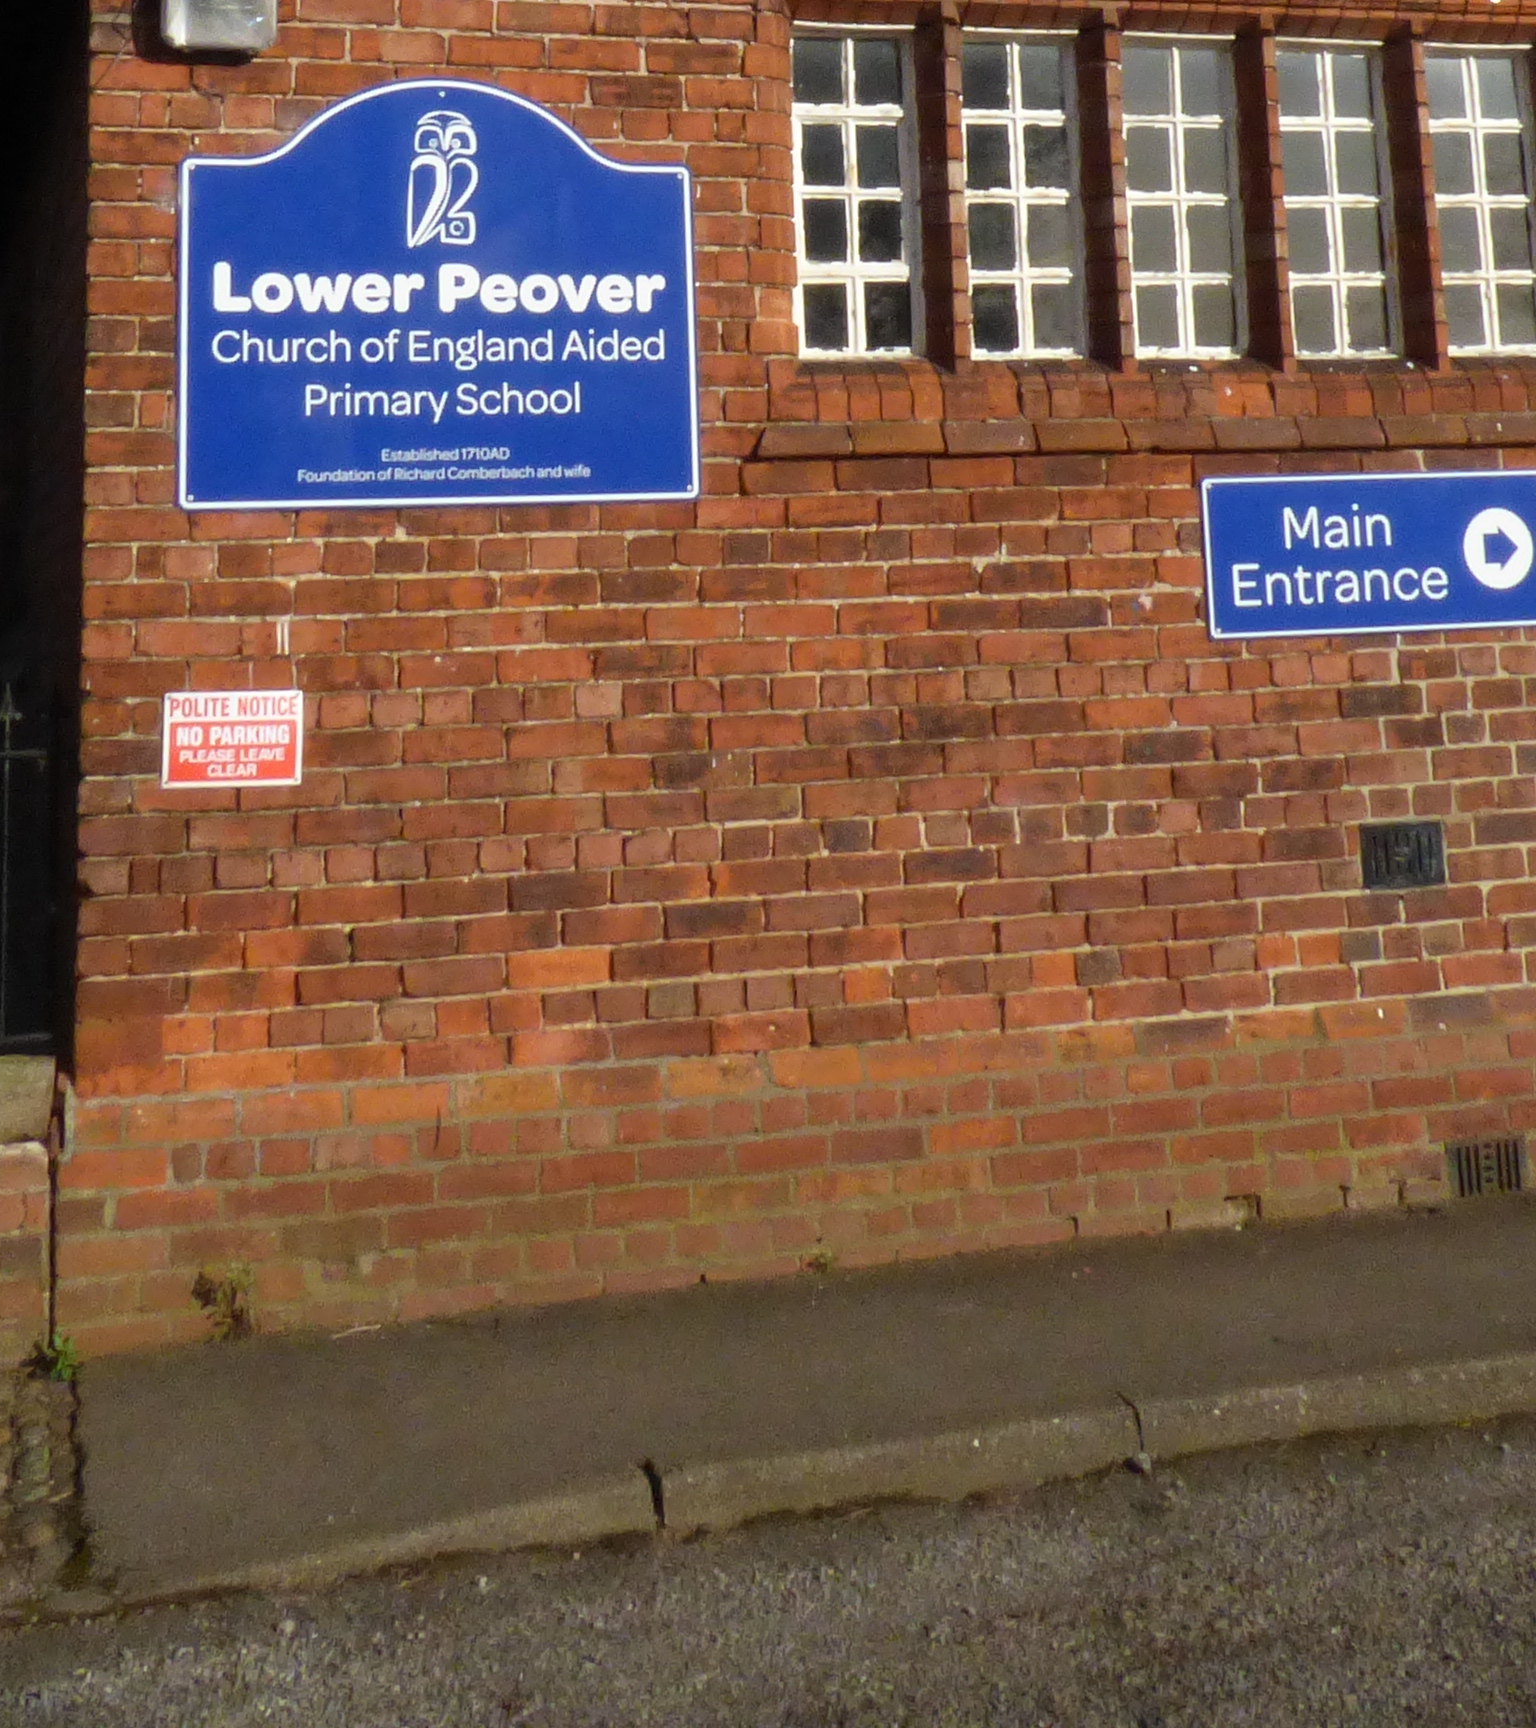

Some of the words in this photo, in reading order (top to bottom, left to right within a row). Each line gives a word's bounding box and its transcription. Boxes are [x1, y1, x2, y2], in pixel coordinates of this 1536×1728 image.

[212, 261, 425, 313] Lower
[437, 263, 666, 313] Peover
[211, 329, 352, 364] Church
[360, 329, 402, 363] of
[408, 329, 554, 371] England
[561, 328, 666, 362] Aided
[304, 383, 447, 424] Primary
[455, 381, 582, 415] School
[381, 447, 460, 462] Established
[461, 446, 511, 461] 1710AD
[297, 468, 376, 483] Foundation
[377, 467, 394, 481] of
[393, 466, 446, 481] Richard
[446, 465, 536, 480] Comberbach
[536, 464, 563, 478] and
[562, 463, 592, 478] wife
[1282, 503, 1393, 550] Main
[1231, 562, 1450, 607] Entrance
[169, 697, 230, 718] POLITE
[238, 695, 298, 717] NOTICE
[176, 726, 203, 747] NO
[209, 724, 291, 746] PARKING
[179, 749, 235, 764] PLEASE
[239, 747, 285, 762] LEAVE
[207, 763, 257, 778] CLEAR
